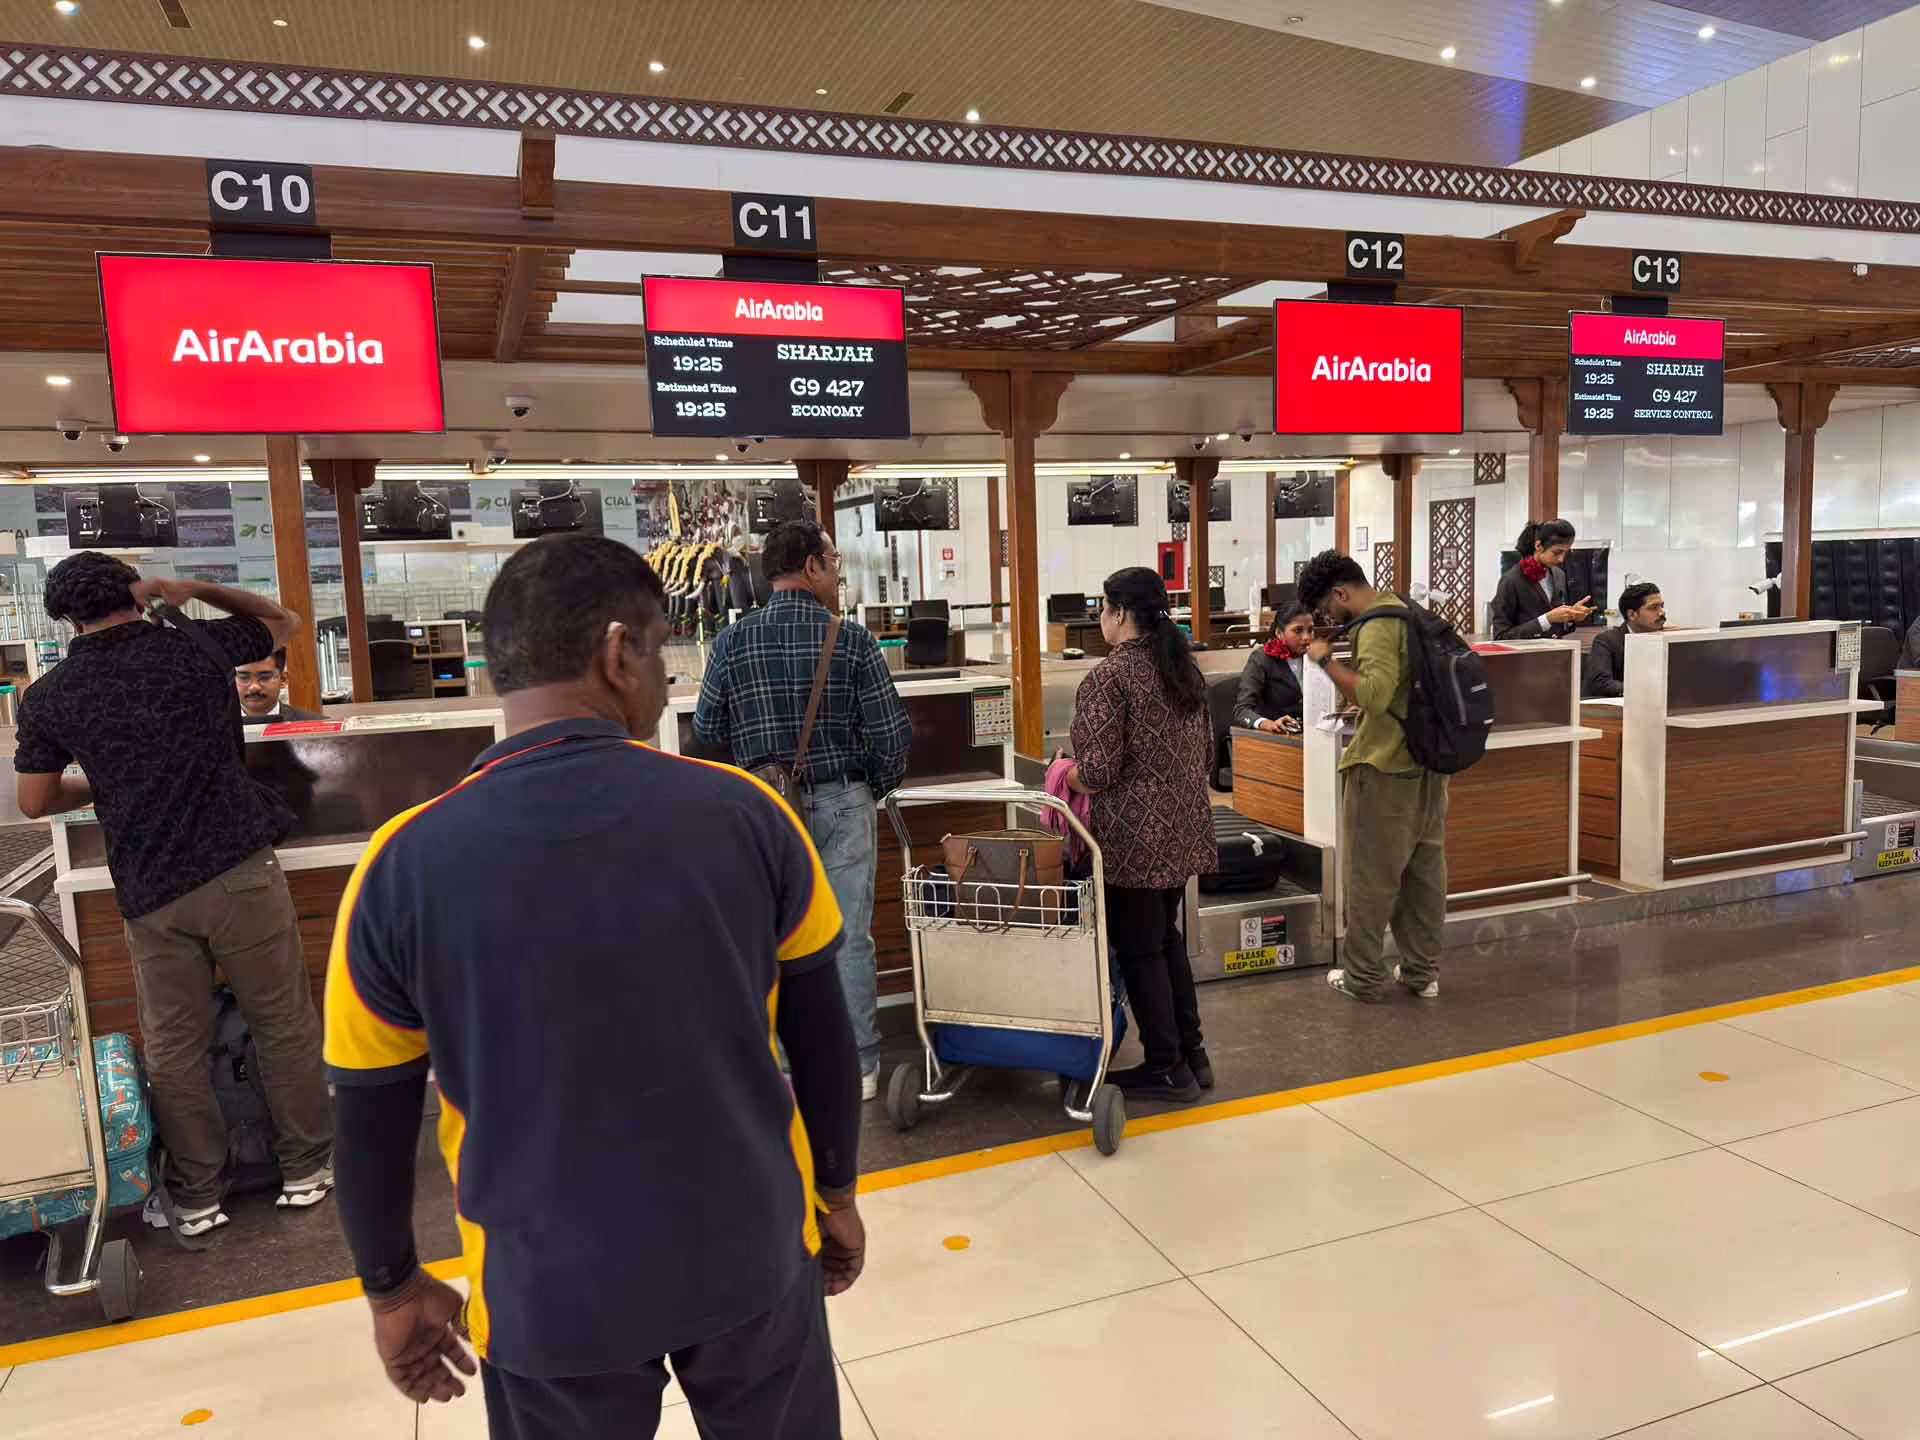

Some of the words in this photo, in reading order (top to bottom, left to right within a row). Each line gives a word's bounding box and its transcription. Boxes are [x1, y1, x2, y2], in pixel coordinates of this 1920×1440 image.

[211, 170, 310, 214] C10
[739, 202, 811, 240] C11
[1348, 238, 1403, 270] C12
[1633, 255, 1680, 285] C13
[735, 297, 824, 322] AirArabia
[654, 336, 706, 348] Scheduled
[707, 337, 734, 349] Time
[1623, 328, 1677, 346] AirArabia
[172, 328, 384, 365] AirArabia
[776, 343, 874, 362] SHARJAH
[672, 355, 723, 373] 19:25
[1311, 354, 1431, 383] AirArabia
[1574, 358, 1604, 367] Scheduled
[1605, 359, 1622, 367] Time
[1646, 363, 1705, 377] SHARJAH
[1584, 373, 1615, 385] 19:25
[656, 381, 709, 394] Estimated
[710, 383, 737, 394] Time
[790, 377, 820, 397] G9
[825, 380, 865, 397] 427
[1574, 392, 1604, 401] Estimated
[1605, 393, 1621, 401] Time
[1652, 388, 1671, 403] G9
[1673, 390, 1697, 404] 427
[675, 401, 726, 417] 19:25
[791, 404, 864, 418] ECONOMY
[1583, 407, 1614, 419] 19:25
[1633, 409, 1672, 419] SERVICE
[1673, 409, 1713, 420] CONTROL
[604, 496, 633, 507] CIAL
[1885, 850, 1905, 860] PLEASE
[1236, 949, 1265, 961] PLEASE
[1226, 961, 1249, 971] KEEP
[1249, 958, 1276, 968] CLEAR
